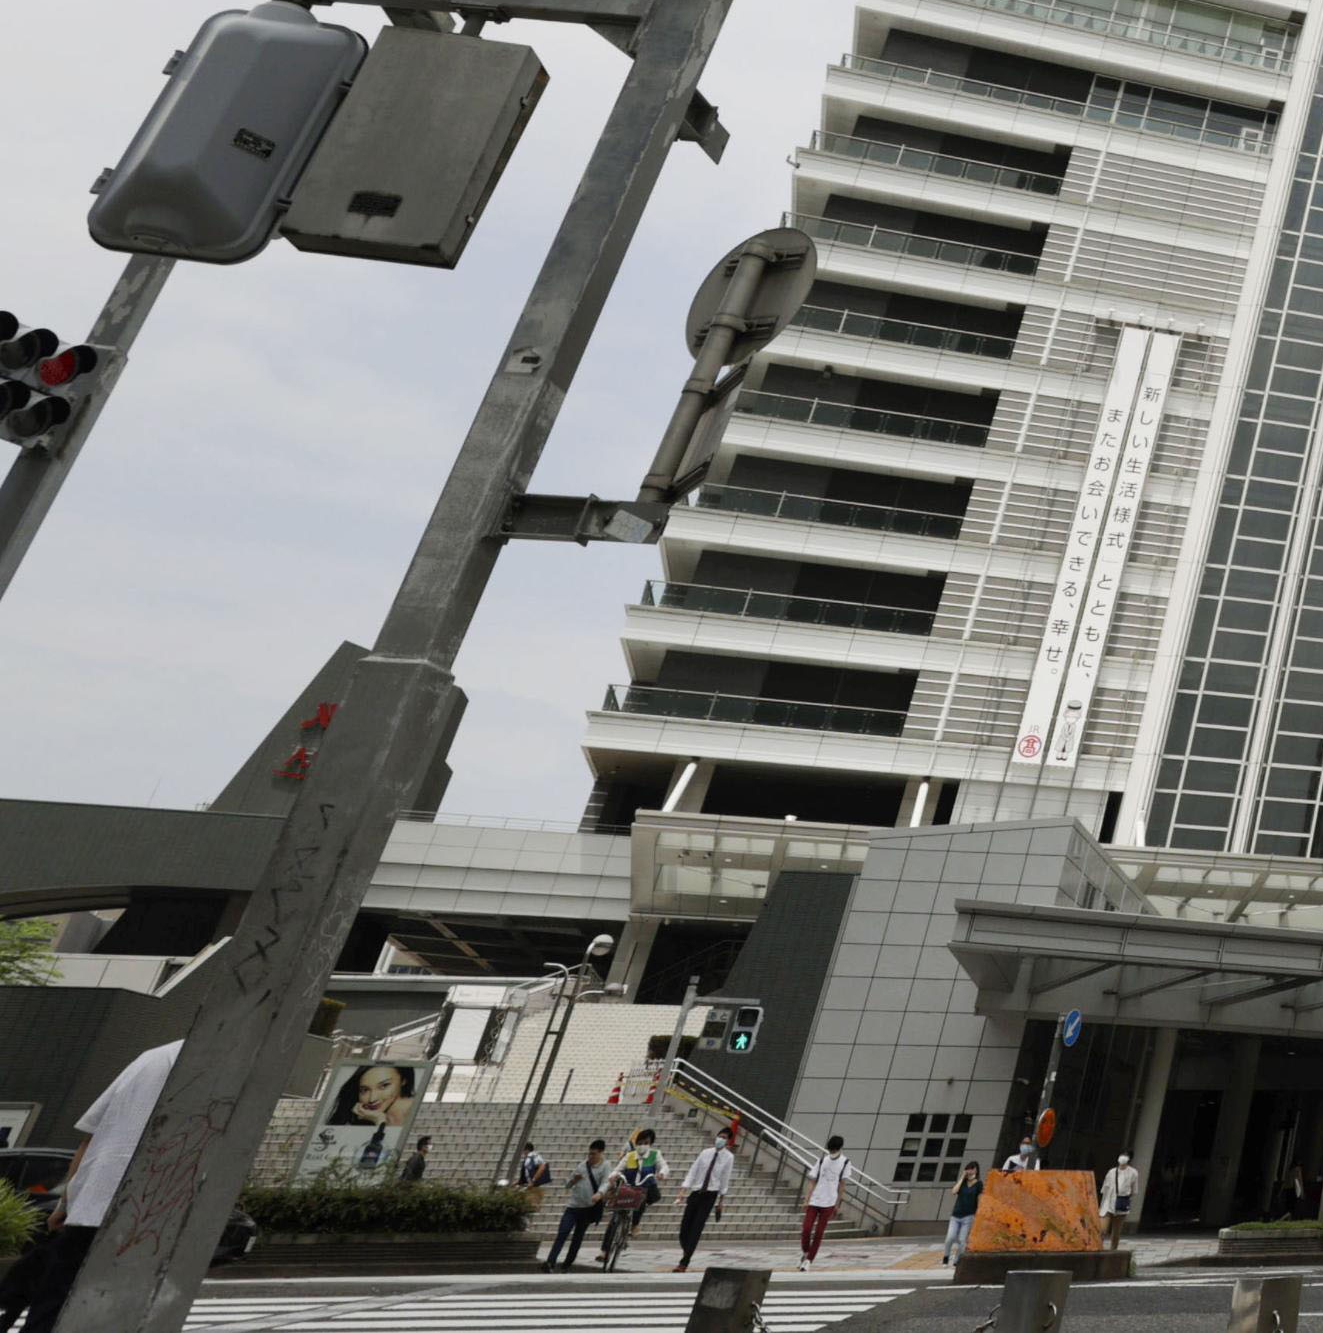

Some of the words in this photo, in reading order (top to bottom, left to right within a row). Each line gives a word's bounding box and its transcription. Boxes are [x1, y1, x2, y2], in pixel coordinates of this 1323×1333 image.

[1045, 409, 1123, 675] またお会いできる、幸せ。
[1028, 724, 1040, 733] JR
